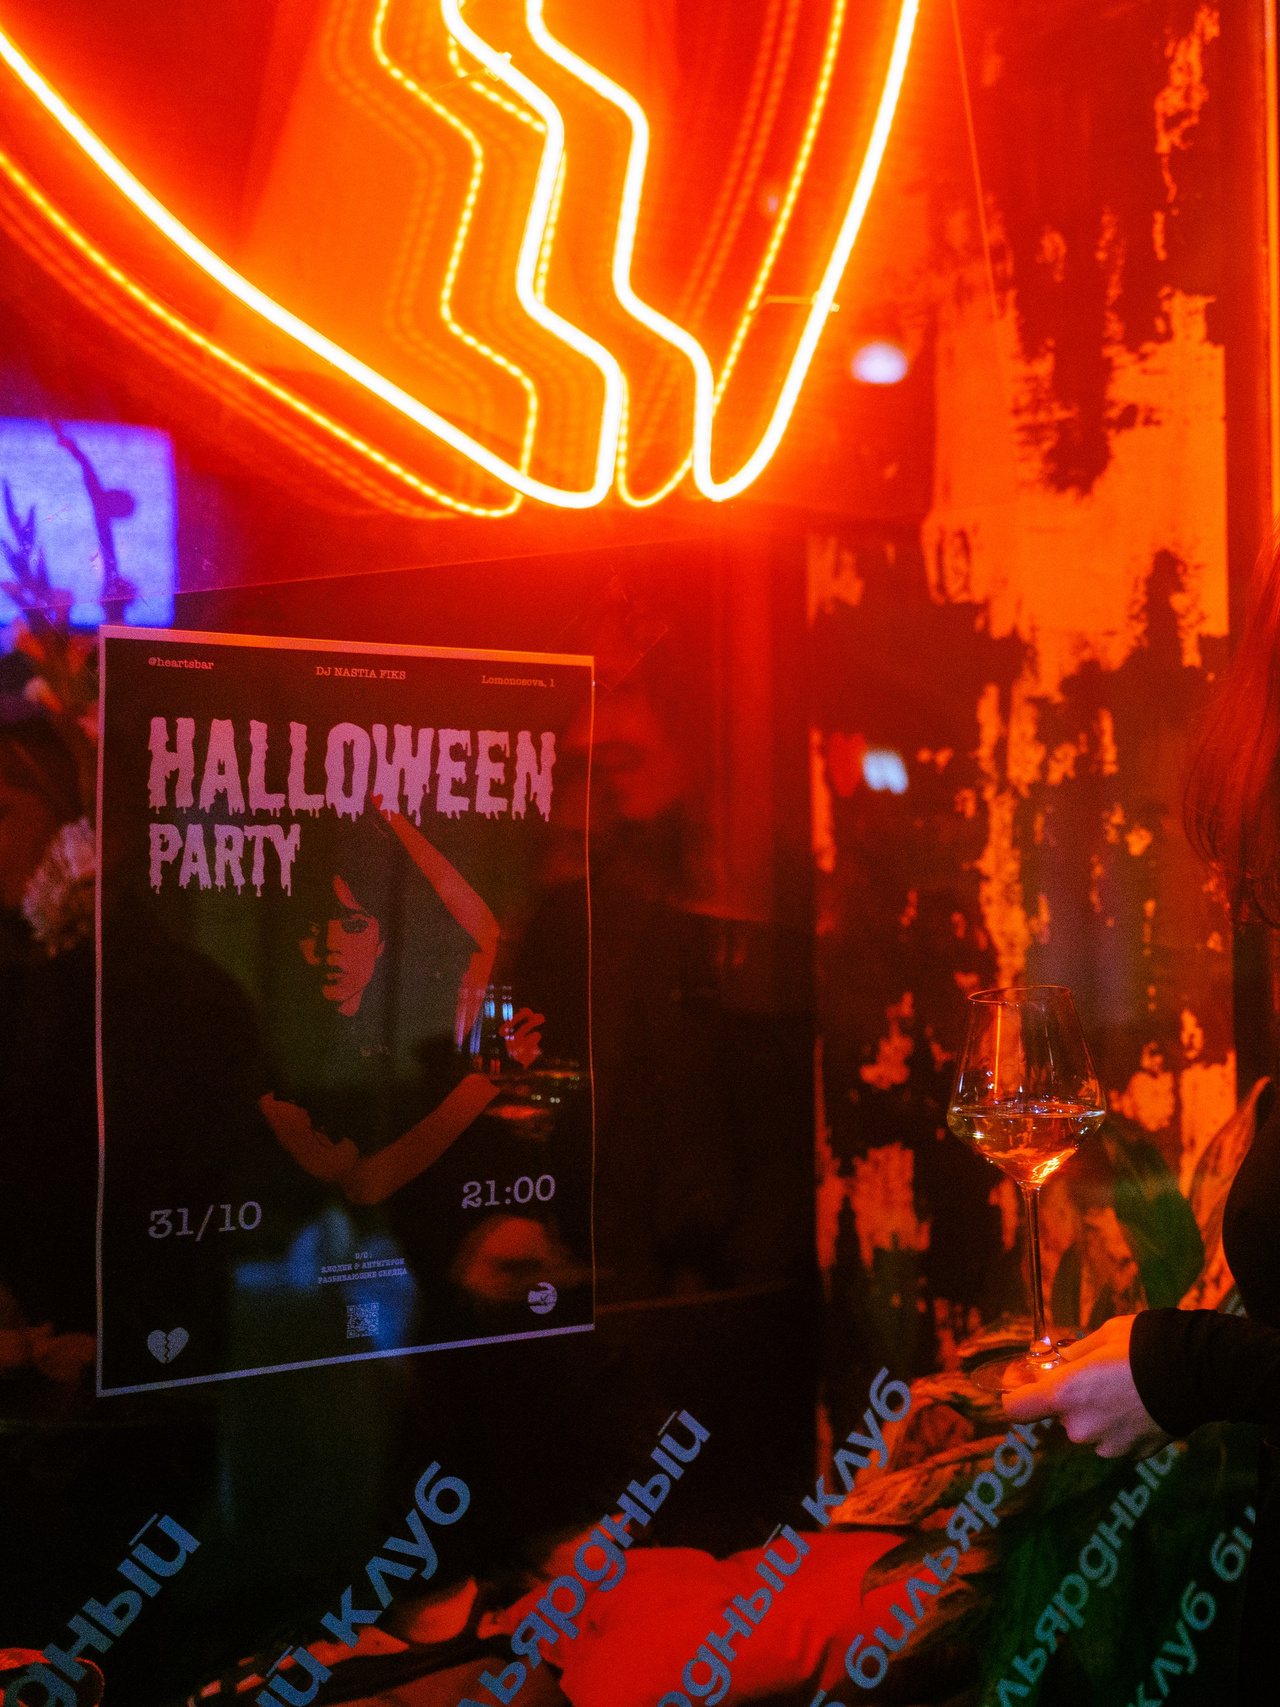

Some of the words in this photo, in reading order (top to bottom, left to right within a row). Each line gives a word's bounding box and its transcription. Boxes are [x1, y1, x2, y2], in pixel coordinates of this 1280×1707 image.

[148, 657, 215, 670] @heartsbar
[315, 666, 331, 677] DJ
[334, 667, 377, 679] NASTIA
[379, 670, 407, 680] FIKS
[147, 716, 557, 826] HALLOWEEN
[149, 823, 301, 898] PARTY
[147, 1200, 263, 1242] 31/10
[461, 1173, 557, 1209] 21:00
[802, 1367, 912, 1527] клуб
[320, 1461, 471, 1649] клуб
[457, 1409, 711, 1707] ьярдный
